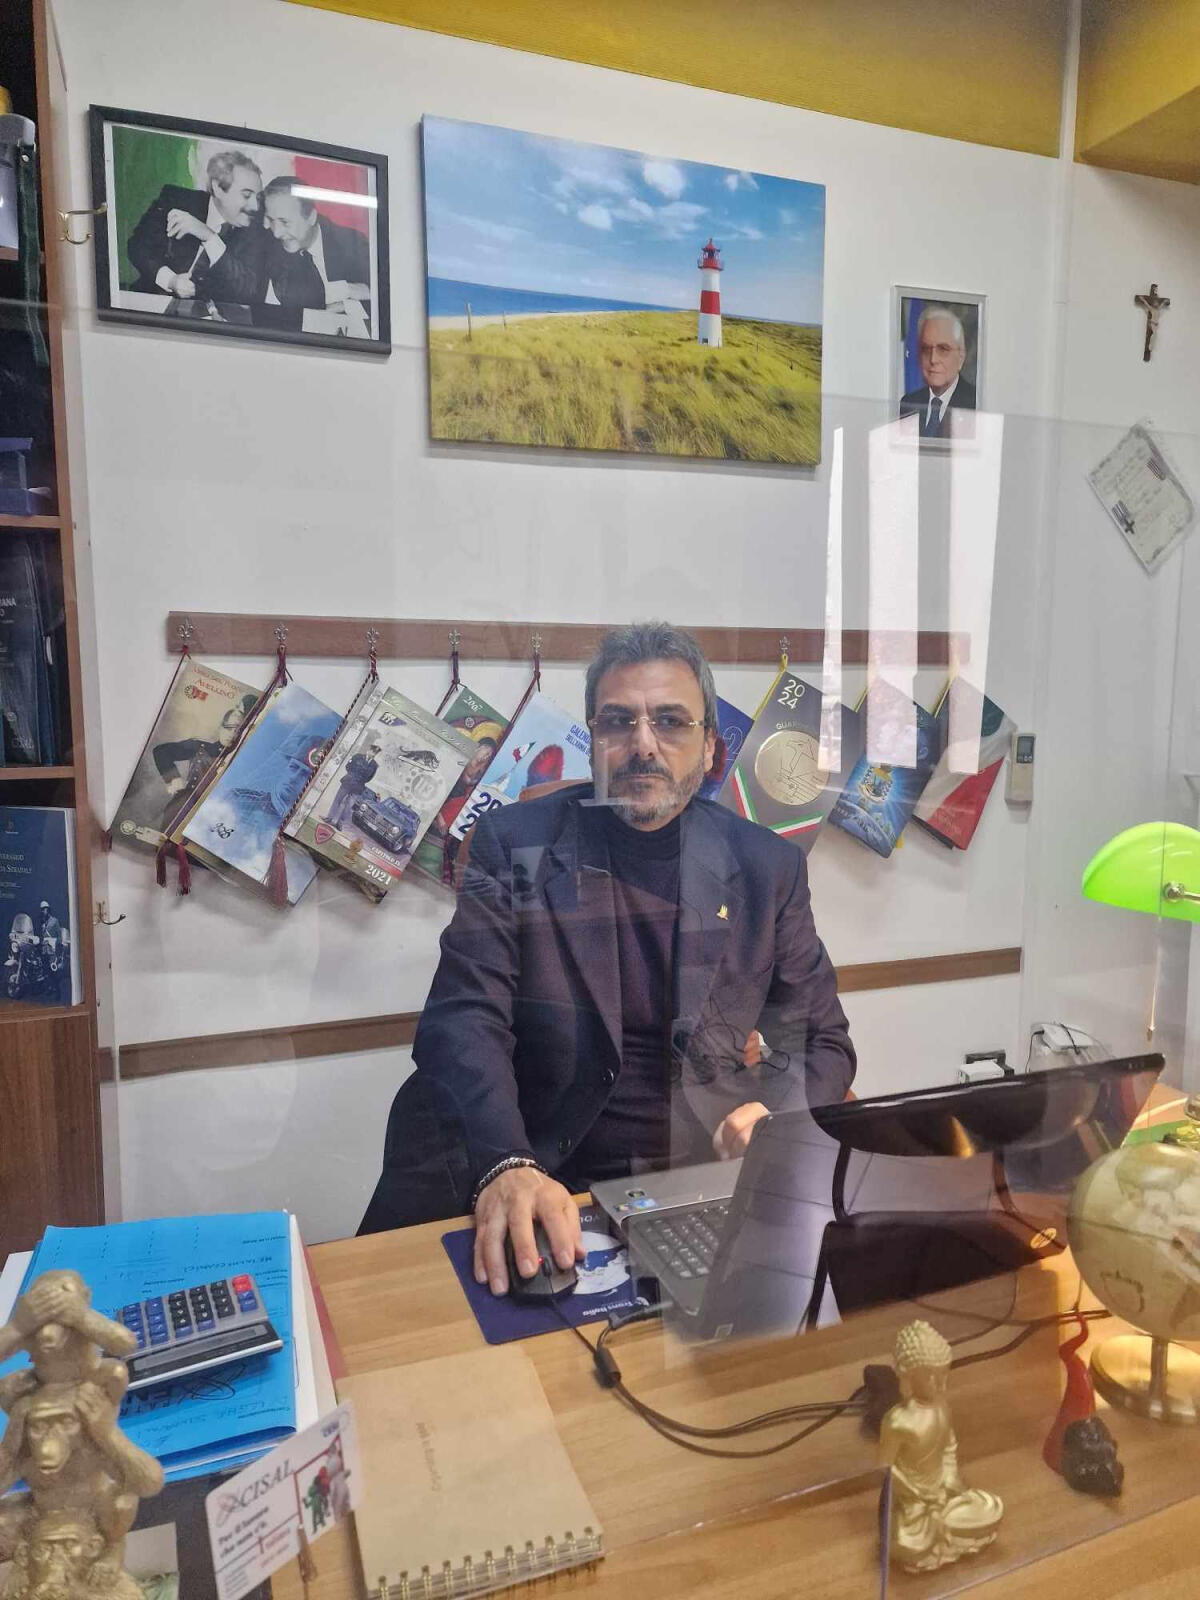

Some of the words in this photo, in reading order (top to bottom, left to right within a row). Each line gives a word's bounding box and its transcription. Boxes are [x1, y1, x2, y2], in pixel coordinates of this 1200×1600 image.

[784, 679, 806, 698] 20
[777, 691, 798, 710] 24
[365, 864, 392, 885] 2021
[240, 1459, 295, 1508] CISAL
